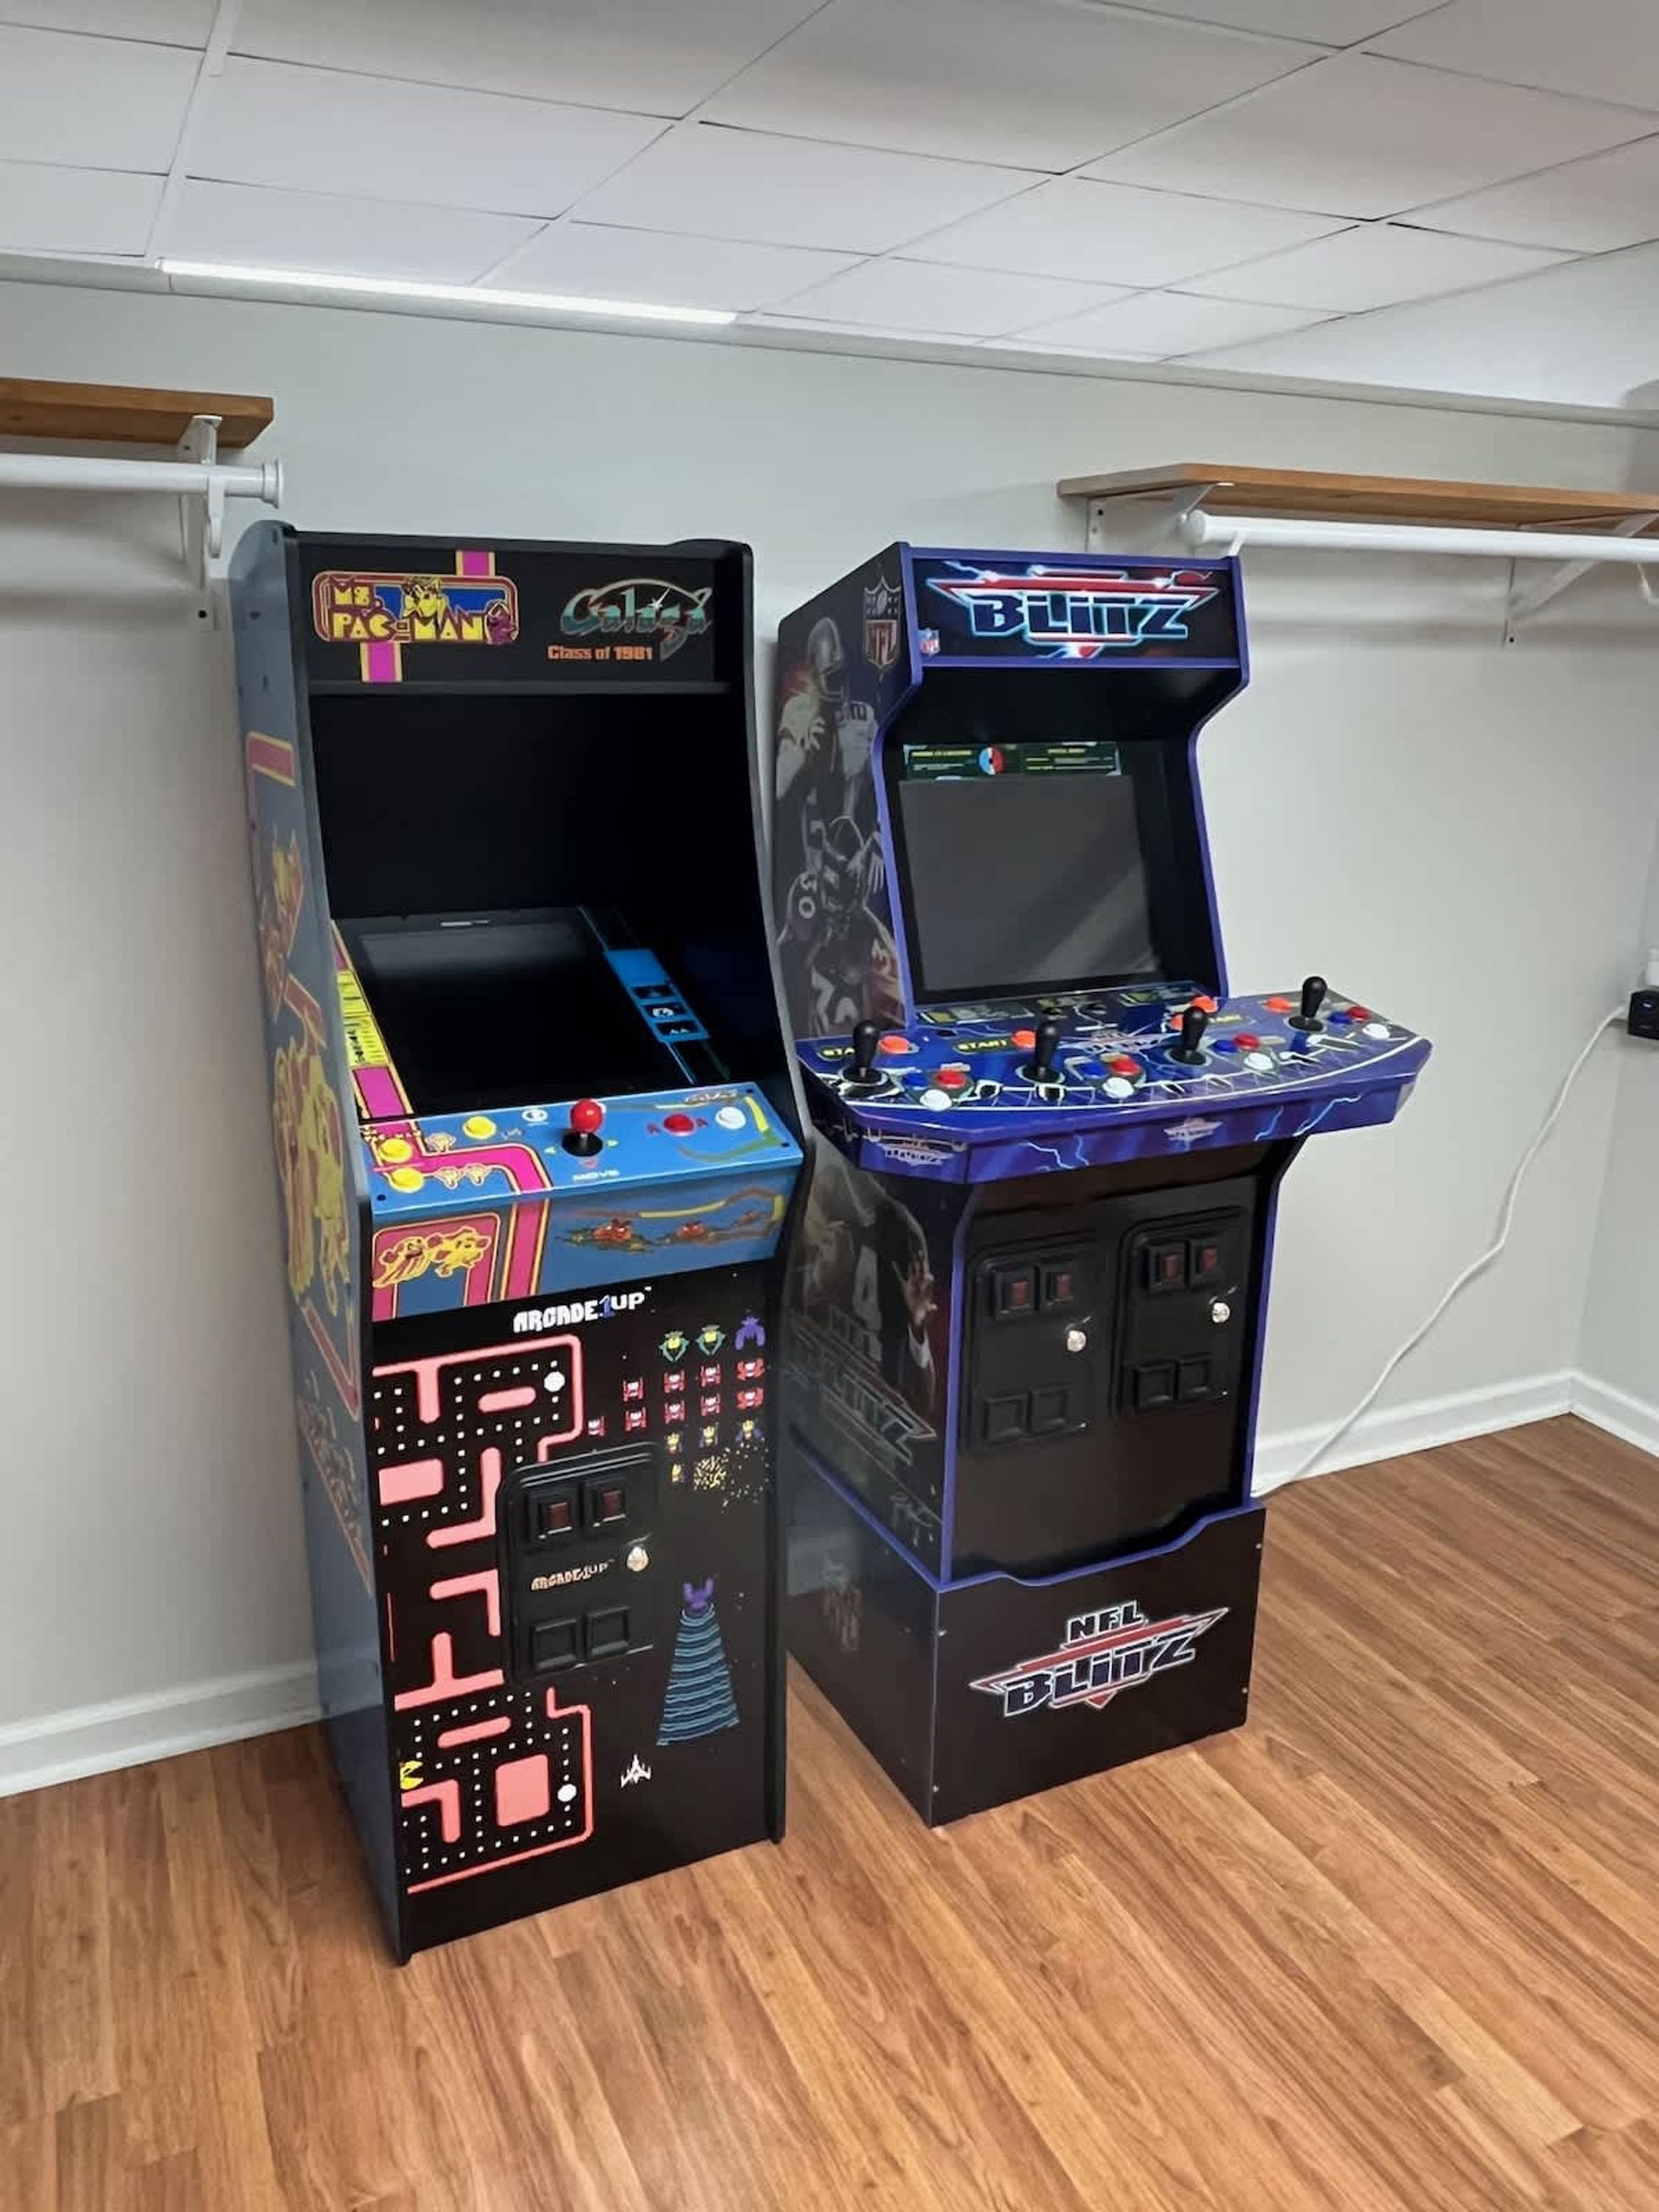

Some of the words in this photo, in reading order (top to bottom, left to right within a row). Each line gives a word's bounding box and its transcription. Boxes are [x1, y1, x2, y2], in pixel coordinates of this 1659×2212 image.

[332, 611, 485, 640] PAC-MAN
[560, 578, 712, 661] Galaga
[970, 591, 1199, 637] BLITZ
[548, 645, 591, 659] Class
[595, 646, 611, 659] of
[613, 646, 653, 659] 1981
[822, 1047, 855, 1057] STA
[957, 1039, 1009, 1051] START
[1068, 1600, 1146, 1643] NFL
[1004, 1627, 1197, 1717] BLITZ
